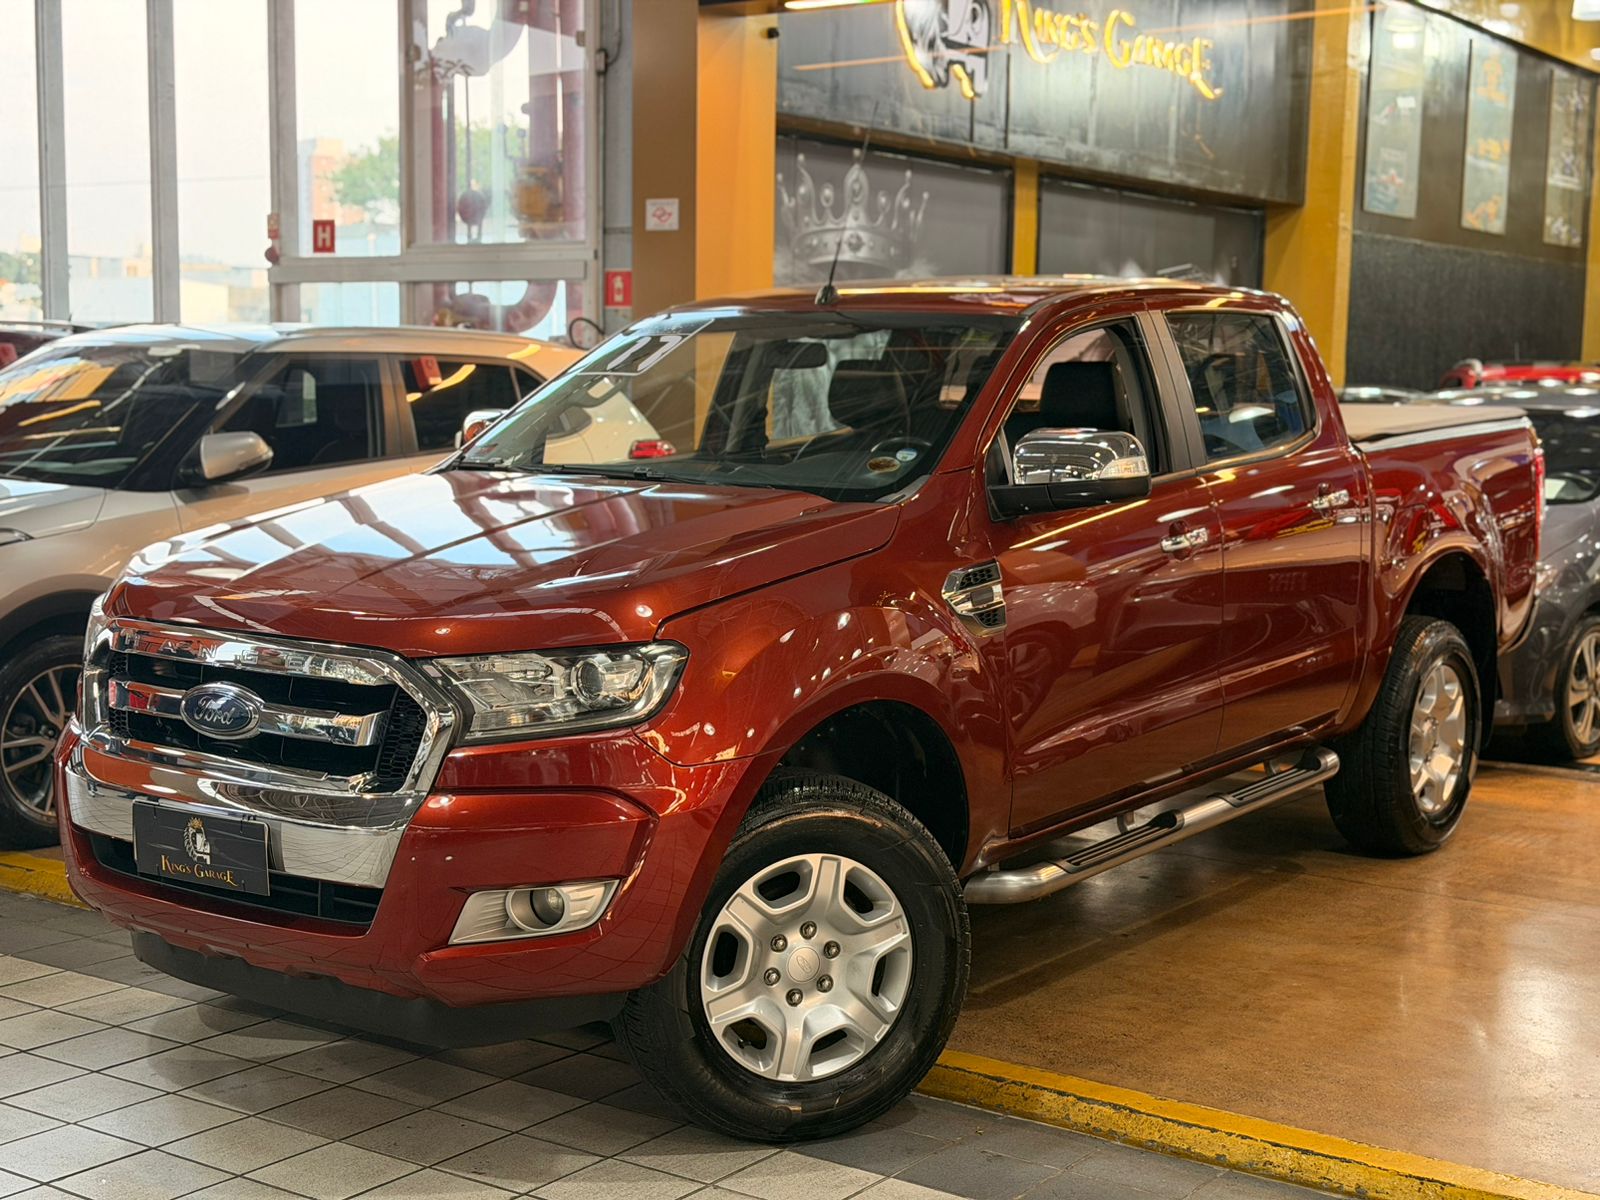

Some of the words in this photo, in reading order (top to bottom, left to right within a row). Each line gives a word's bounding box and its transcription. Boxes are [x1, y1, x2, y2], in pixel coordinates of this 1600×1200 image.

[317, 224, 331, 248] H
[193, 695, 236, 725] Ford
[194, 863, 239, 886] GARAGE
